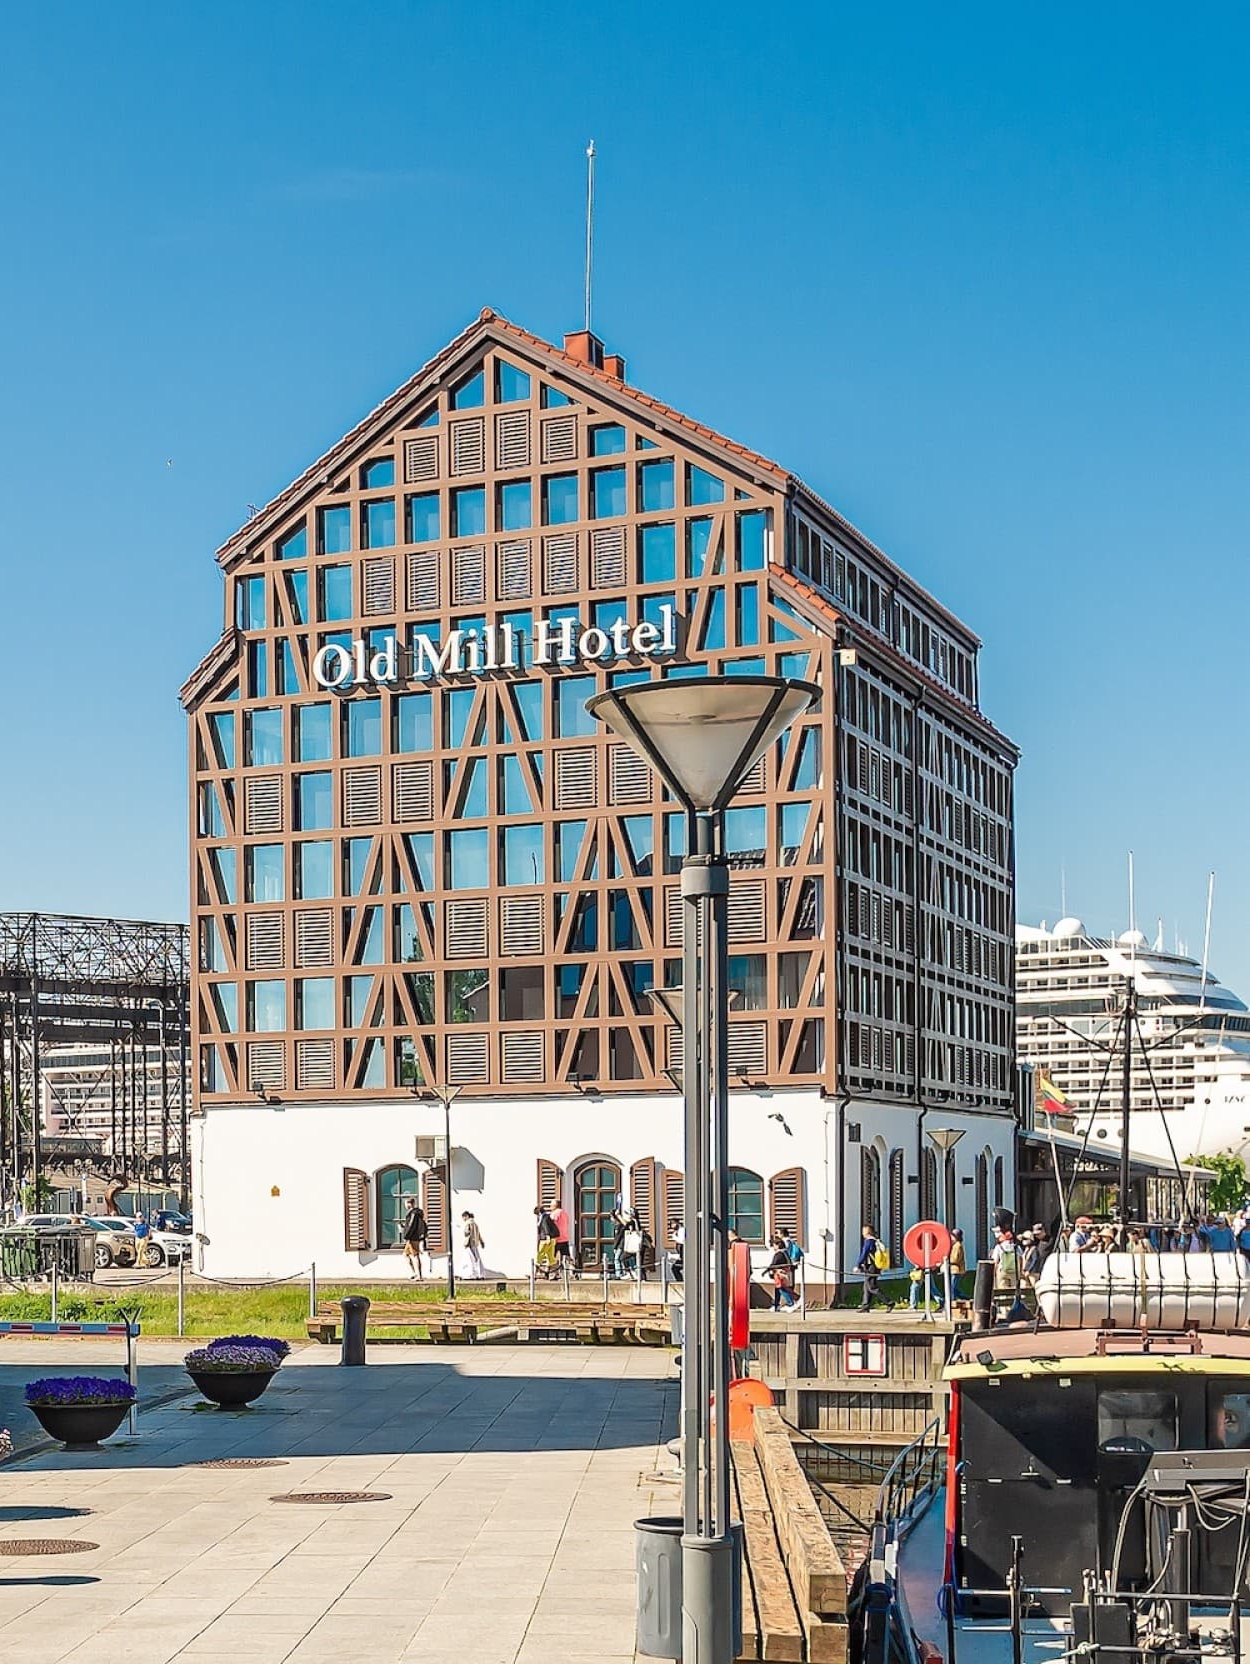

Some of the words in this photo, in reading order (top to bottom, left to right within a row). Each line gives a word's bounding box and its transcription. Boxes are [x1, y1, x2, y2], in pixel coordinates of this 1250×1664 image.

[313, 636, 398, 687] Old
[413, 622, 516, 677] Mill
[533, 604, 676, 665] Hotel
